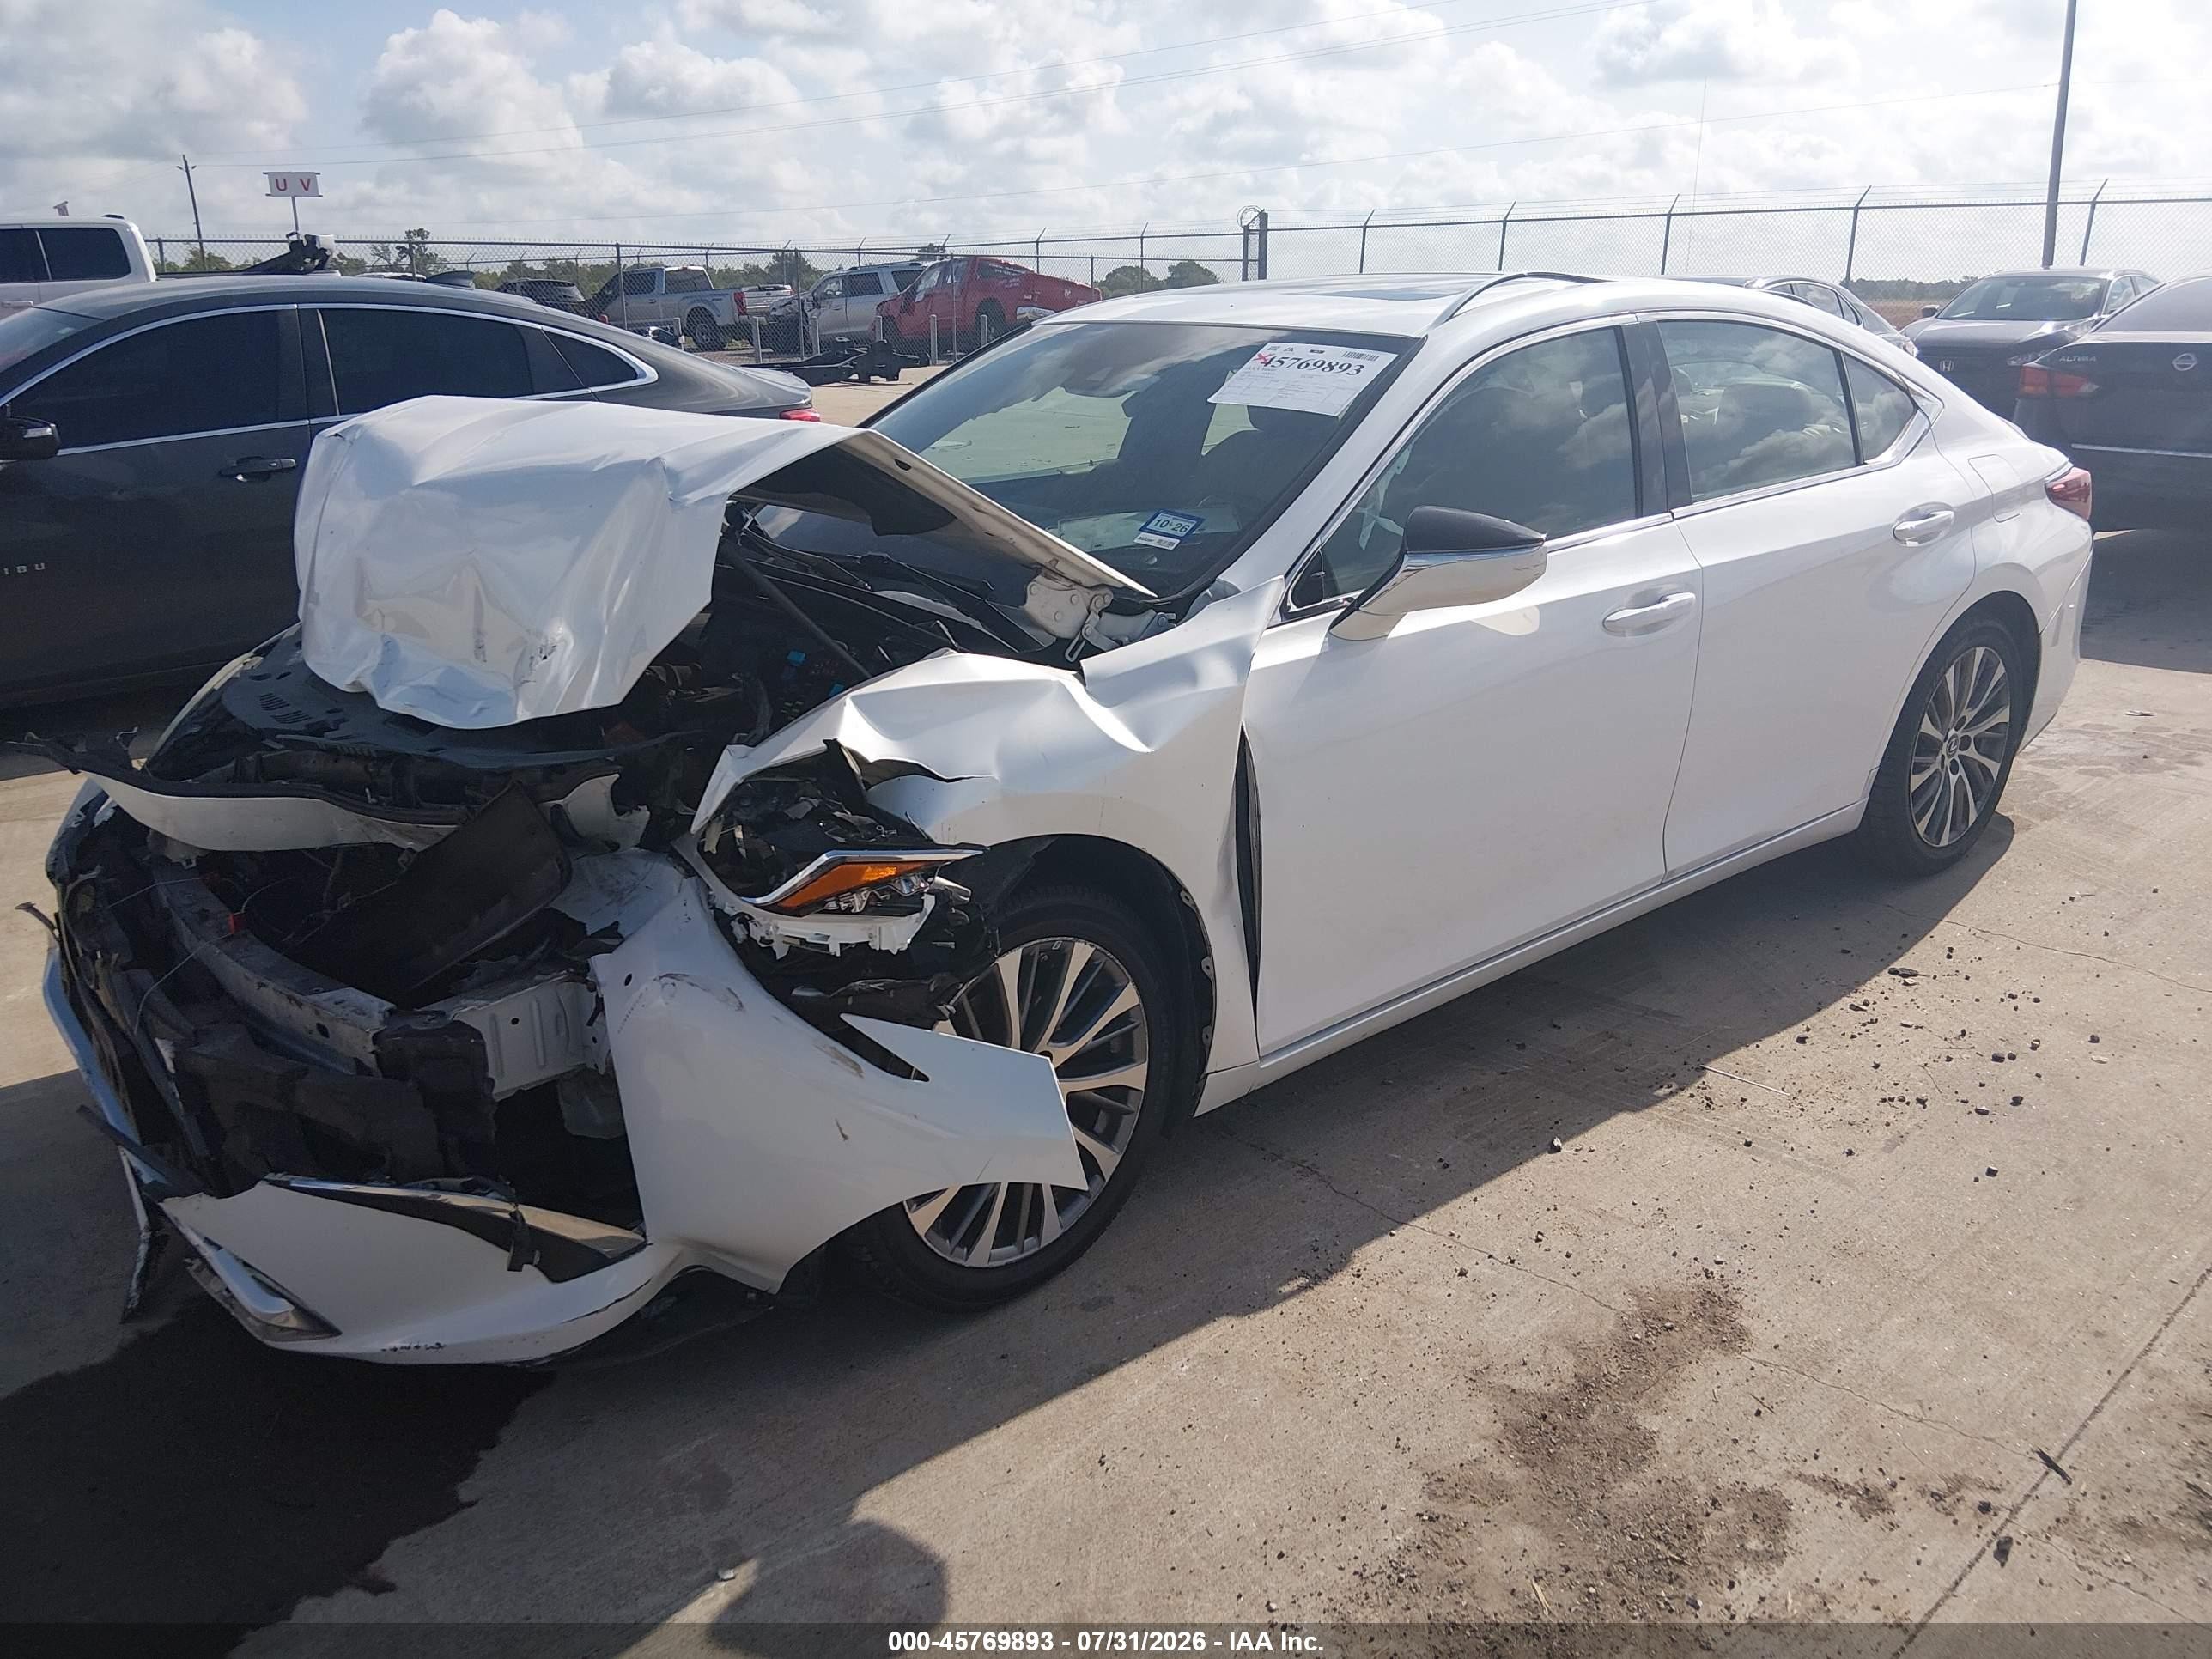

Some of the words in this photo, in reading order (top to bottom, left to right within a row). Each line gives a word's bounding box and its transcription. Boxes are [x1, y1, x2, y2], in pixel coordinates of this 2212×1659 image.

[275, 178, 288, 191] U
[299, 178, 311, 191] V
[1261, 356, 1365, 376] 45769893
